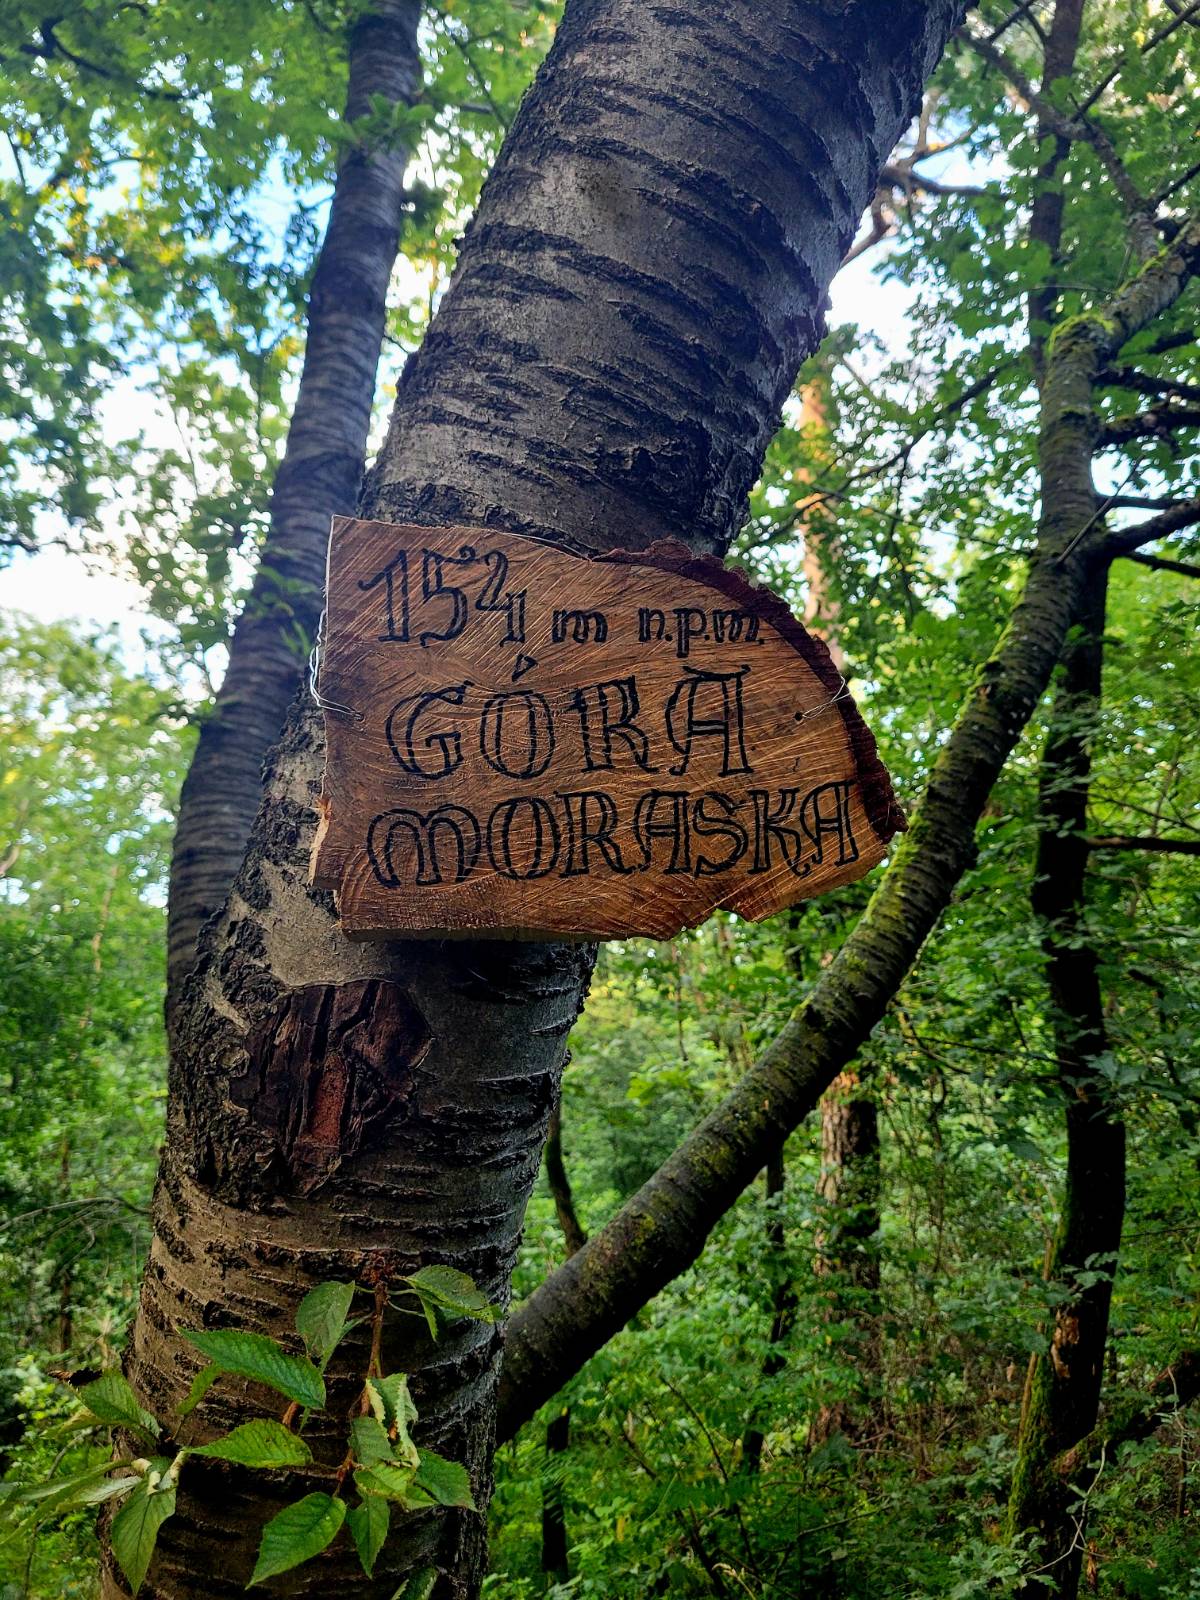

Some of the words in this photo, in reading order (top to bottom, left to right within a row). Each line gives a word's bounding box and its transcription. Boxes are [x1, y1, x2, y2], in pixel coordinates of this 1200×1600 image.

[358, 545, 527, 647] 154
[552, 607, 608, 644] m
[385, 653, 754, 780] GÓRA
[366, 779, 861, 888] MORASKA
